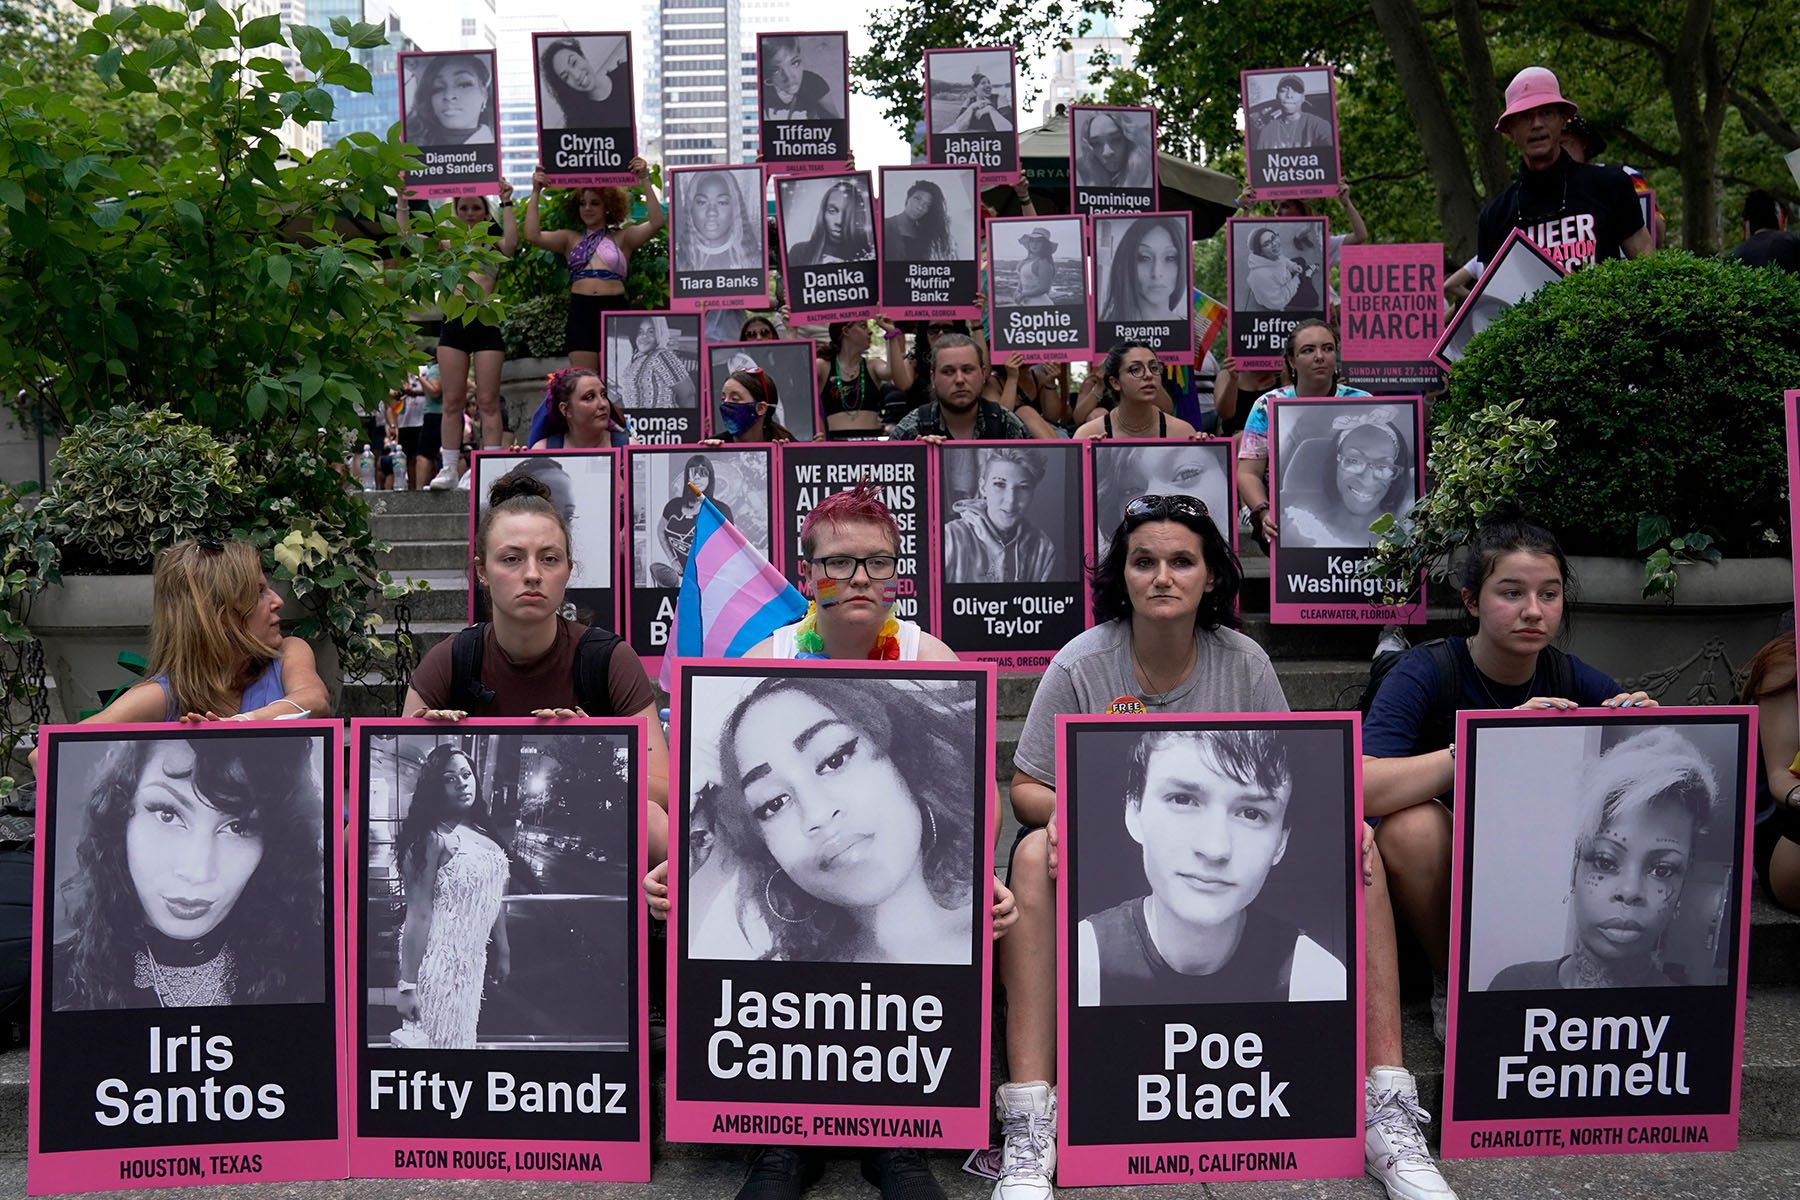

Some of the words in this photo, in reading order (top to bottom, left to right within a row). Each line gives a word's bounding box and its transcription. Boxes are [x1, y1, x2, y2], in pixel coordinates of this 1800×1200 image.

[776, 124, 832, 142] Tiffany
[560, 134, 615, 154] Chyna
[772, 140, 837, 156] Thomas
[944, 138, 1002, 153] Jahaira
[426, 151, 477, 164] Diamond
[556, 150, 622, 167] Carrillo
[946, 152, 1001, 167] DeAlto
[1267, 154, 1318, 168] Novaa
[446, 162, 494, 174] Sanders
[1262, 168, 1325, 182] Watson
[1080, 192, 1150, 208] Dominique
[1520, 214, 1597, 248] UEER
[804, 268, 864, 288] Danika
[909, 264, 951, 276] Bianca
[1348, 264, 1436, 293] QUEER
[680, 277, 713, 290] Tiara
[716, 275, 759, 288] Banks
[803, 286, 869, 304] Henson
[911, 290, 949, 302] Bankz
[1348, 295, 1436, 312] LIBERATION
[1010, 310, 1071, 330] Sophie
[1252, 318, 1300, 333] Jeffre
[1348, 313, 1437, 339] MARCH
[1003, 327, 1078, 346] Vásquez
[1115, 325, 1170, 338] Rayanna
[1348, 367, 1380, 376] SUNDAY
[1383, 367, 1402, 375] JUNE
[1405, 367, 1417, 376] 27,
[1420, 367, 1438, 375] 2021
[624, 414, 688, 431] homas
[636, 431, 682, 445] ardin
[795, 465, 821, 483] WE
[827, 464, 915, 482] REMEMBER
[1287, 574, 1409, 597] Washington
[953, 598, 1008, 615] Oliver
[1300, 609, 1359, 620] CLEARWATER,
[1360, 609, 1397, 619] FLORIDA
[984, 617, 1043, 638] Taylor
[1017, 656, 1050, 666] OREGON
[1112, 702, 1140, 711] FREE
[713, 979, 944, 1033] Jasmine
[1524, 1008, 1671, 1059] Remy
[150, 1025, 234, 1074] Iris
[1164, 1023, 1263, 1070] Poe
[707, 1030, 953, 1094] Cannady
[1497, 1051, 1690, 1100] Fennell
[94, 1076, 286, 1127] Santos
[370, 1070, 473, 1120] Fifty
[487, 1071, 627, 1114] Bandz
[1137, 1071, 1291, 1122] Black
[712, 1114, 808, 1139] AMBRIDGE,
[812, 1116, 944, 1139] PENNSYLVANIA
[1470, 1129, 1566, 1149] CHARLOTTE,
[1569, 1127, 1623, 1147] NORTH
[1627, 1125, 1709, 1145] CAROLINA
[120, 1157, 206, 1180] HOUSTON,
[209, 1154, 263, 1174] TEXAS
[394, 1150, 448, 1169] BATON
[453, 1151, 511, 1173] ROUGE,
[515, 1152, 603, 1172] LOUISIANA
[1128, 1155, 1194, 1177] NILAND,
[1198, 1152, 1298, 1172] CALIFORNIA
